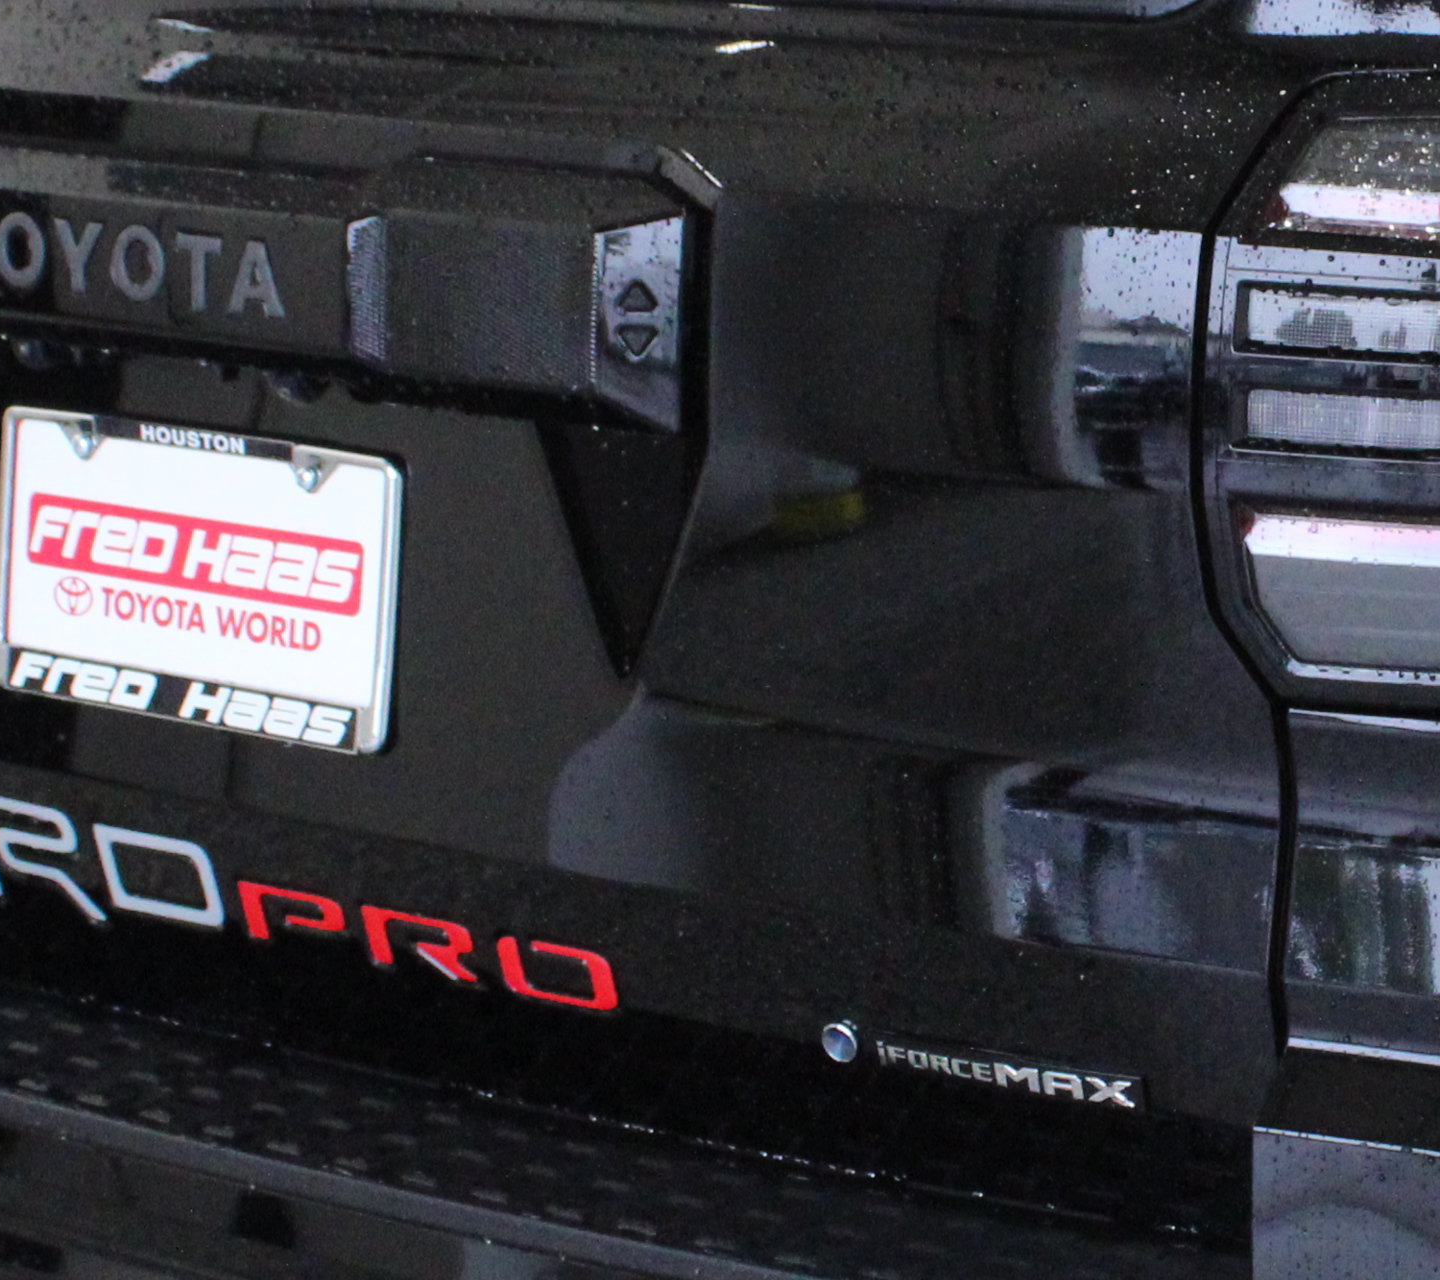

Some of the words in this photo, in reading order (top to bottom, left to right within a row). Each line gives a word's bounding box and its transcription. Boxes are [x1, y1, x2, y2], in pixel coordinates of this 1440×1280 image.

[139, 423, 246, 455] HOUSTON
[101, 586, 206, 634] TOYOTA
[216, 605, 323, 653] WORLD
[237, 880, 619, 1012] PRO
